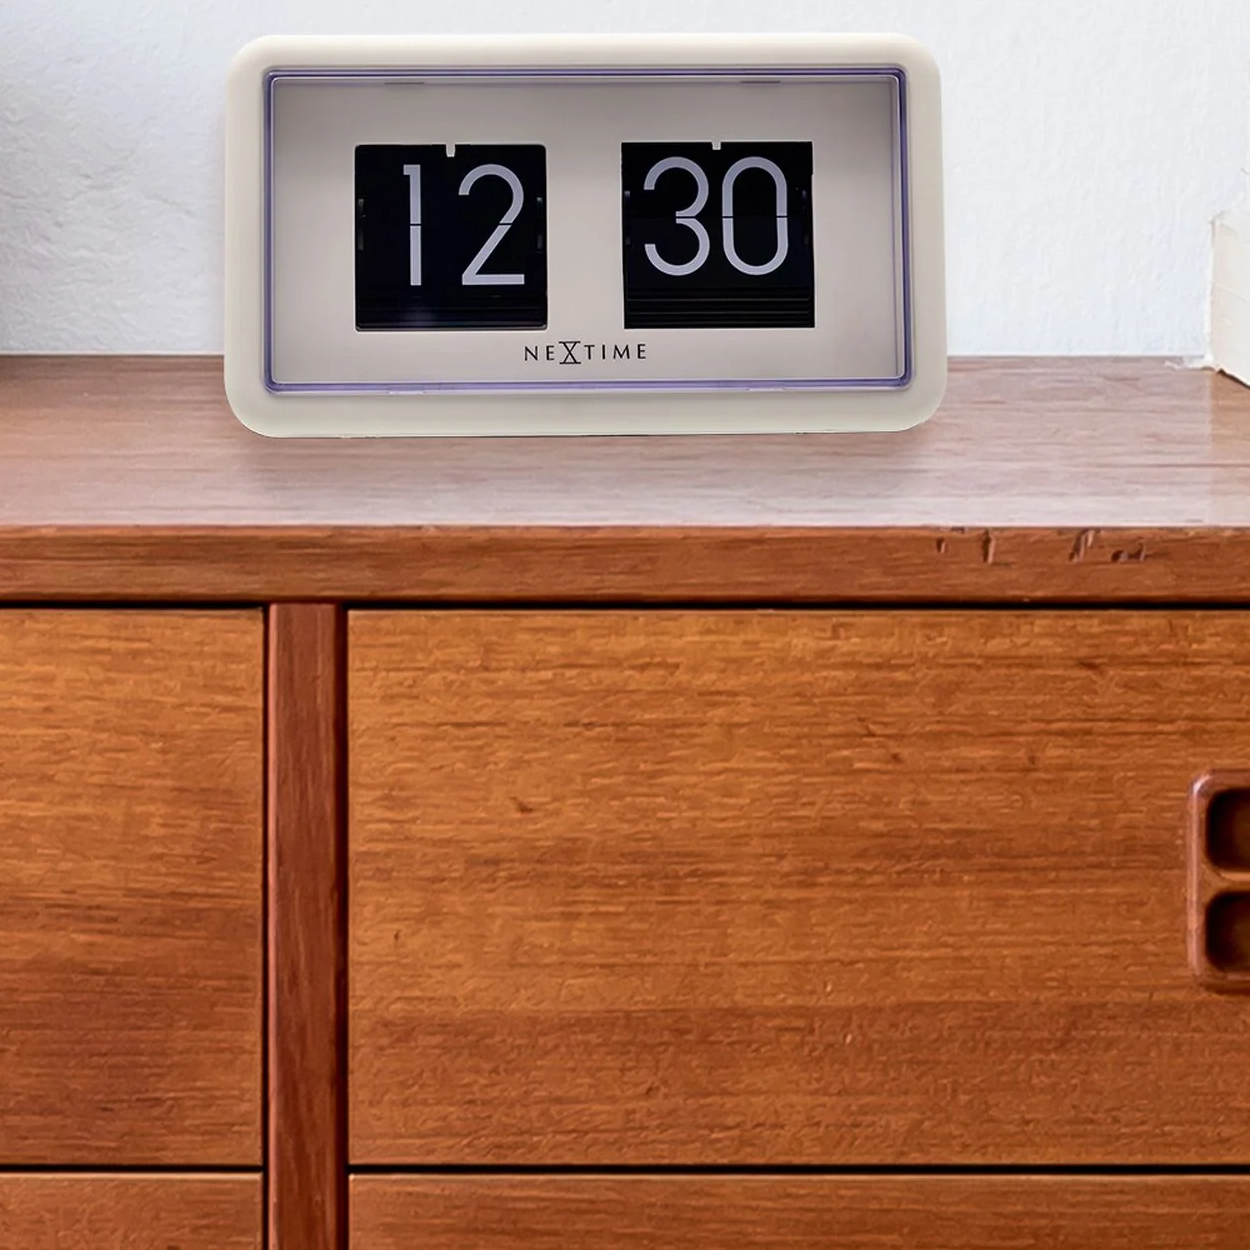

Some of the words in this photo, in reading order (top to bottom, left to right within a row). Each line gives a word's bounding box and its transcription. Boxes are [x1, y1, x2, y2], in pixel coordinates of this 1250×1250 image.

[403, 164, 526, 286] 12
[643, 156, 789, 277] 30
[523, 340, 648, 366] NEXTIME
